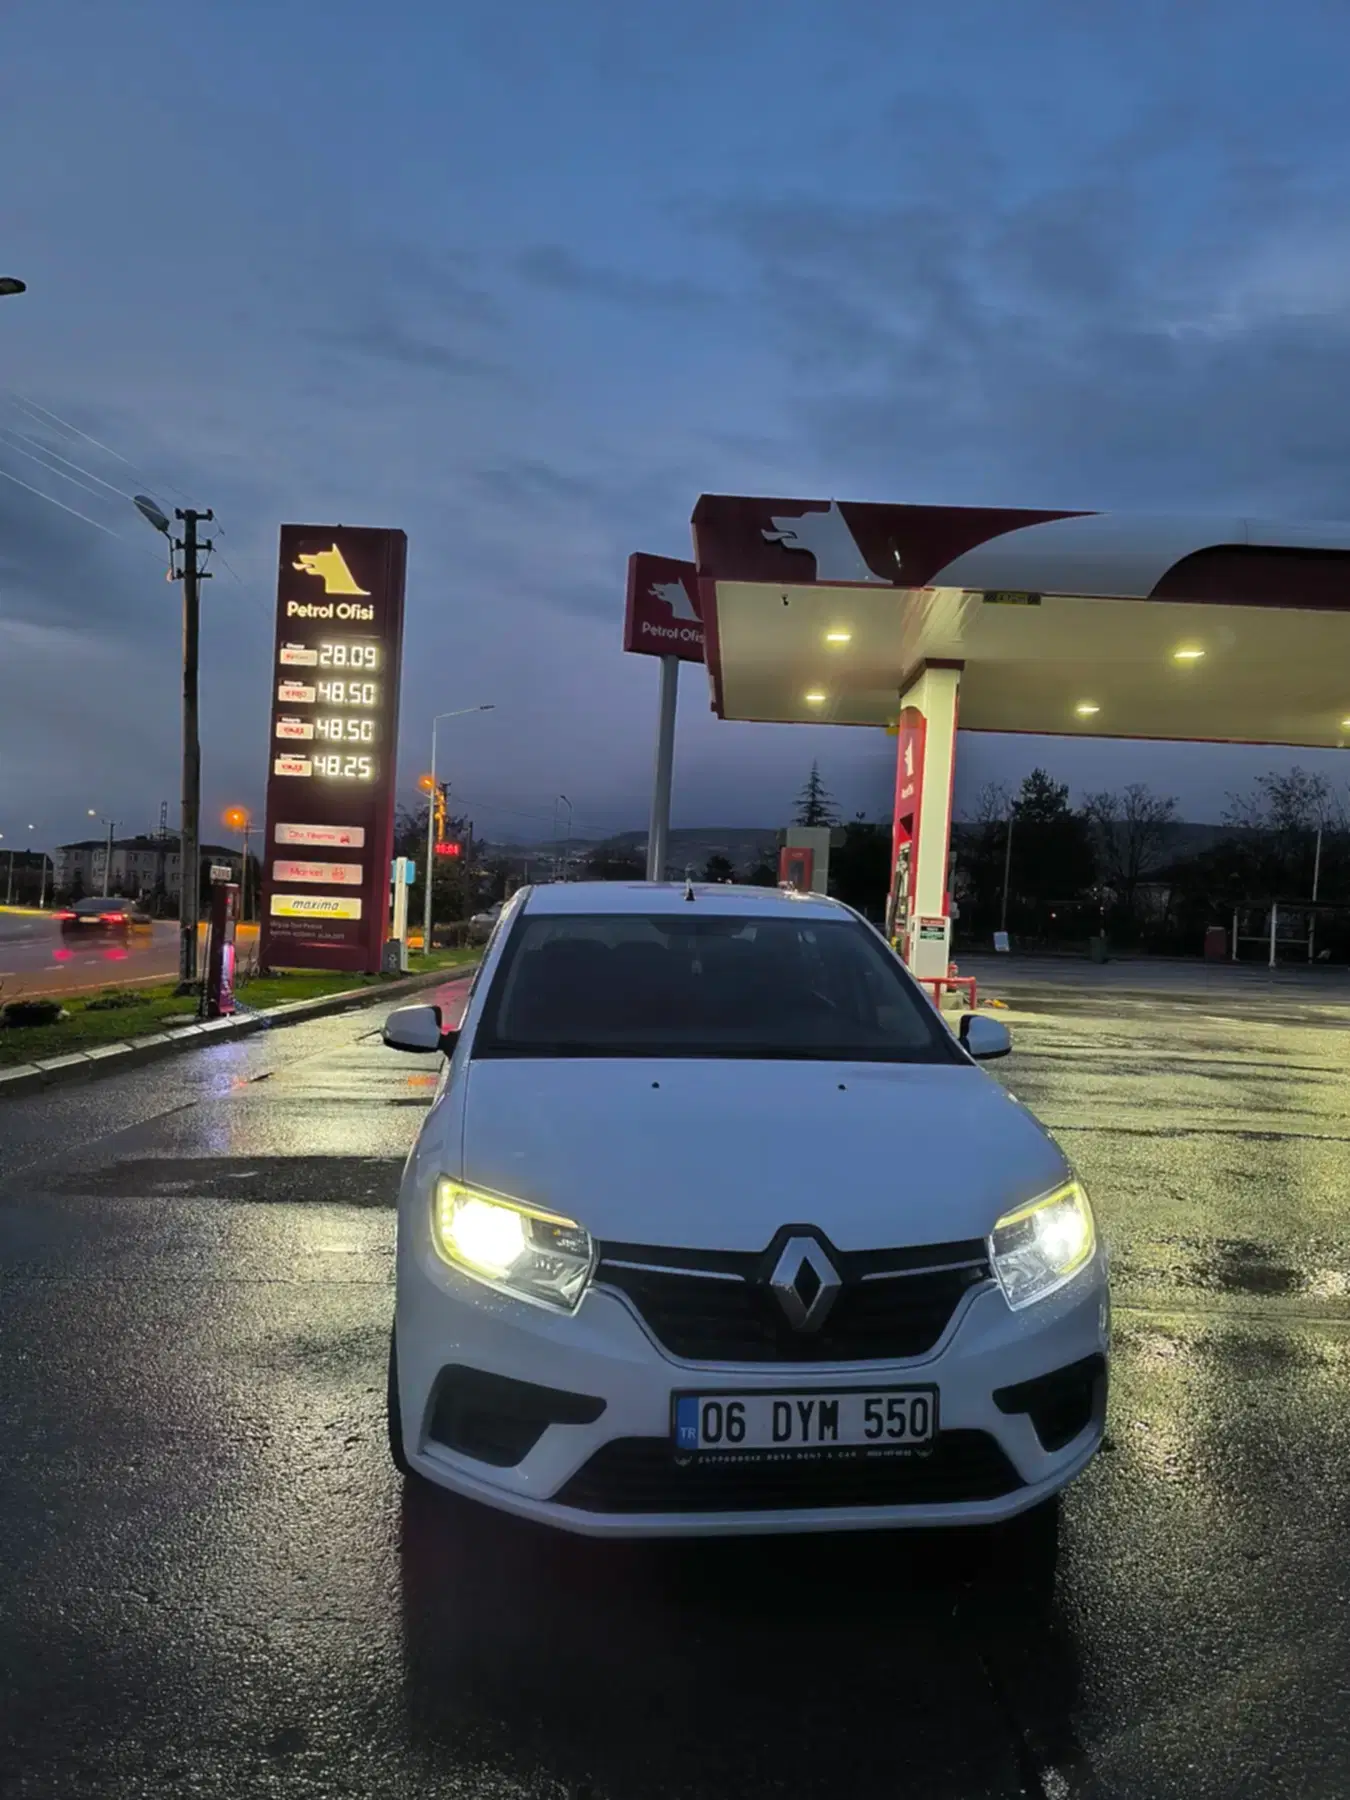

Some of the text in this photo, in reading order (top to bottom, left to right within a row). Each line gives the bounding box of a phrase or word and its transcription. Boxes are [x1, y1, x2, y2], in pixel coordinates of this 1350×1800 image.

[287, 600, 374, 621] Petrol Ofisi
[642, 620, 706, 644] Petrol Ofis
[319, 644, 376, 669] 28.09
[318, 681, 375, 705] 48.50
[316, 716, 373, 741] 48.50
[314, 755, 371, 778] 48.25
[292, 899, 340, 911] maxima
[702, 1397, 929, 1443] 06 DYM 550
[680, 1427, 697, 1440] TR
